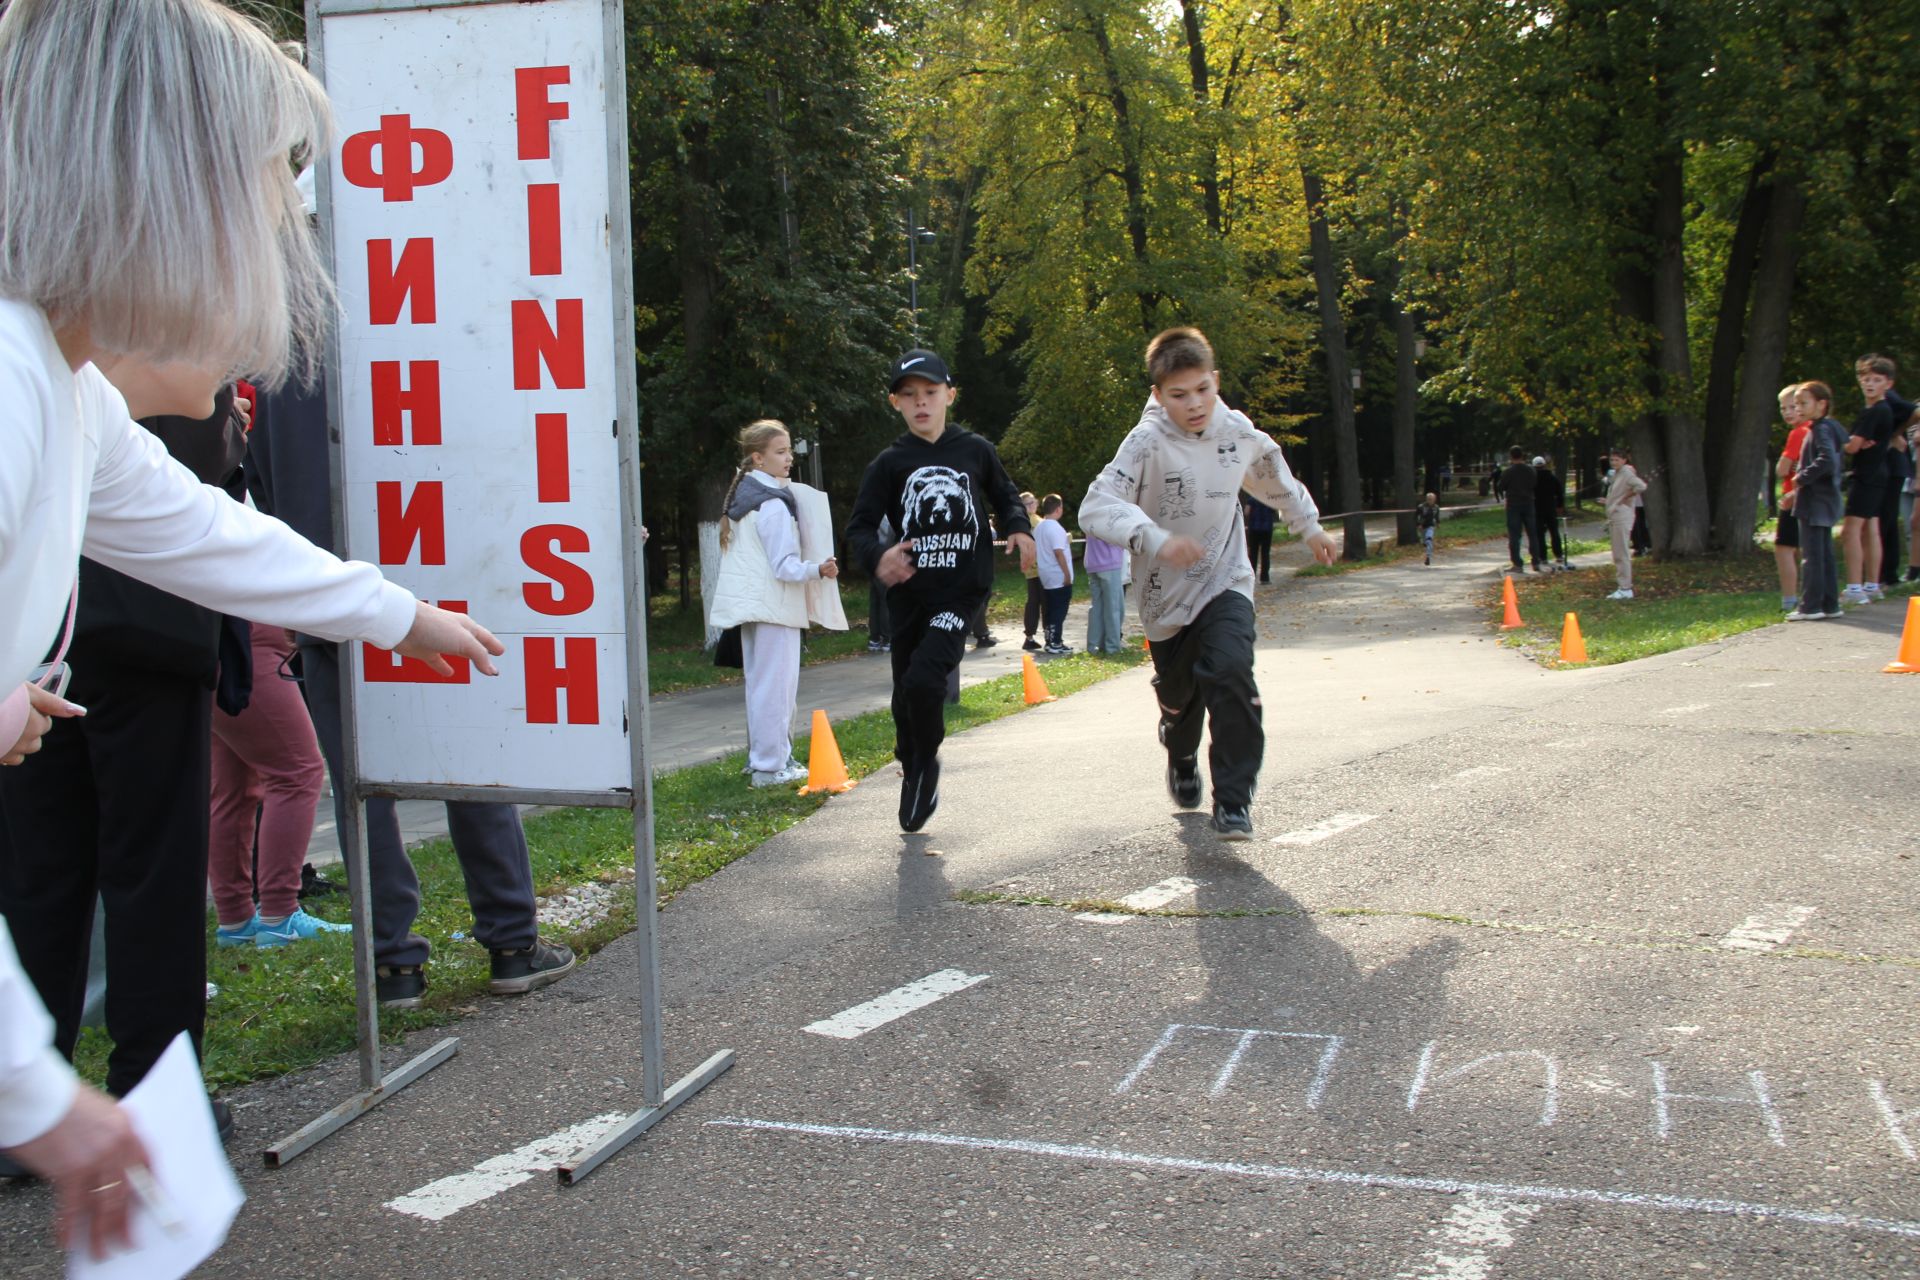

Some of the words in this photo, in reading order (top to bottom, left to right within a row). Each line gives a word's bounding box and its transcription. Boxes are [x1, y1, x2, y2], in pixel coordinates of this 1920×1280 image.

[511, 65, 600, 725] FINISH
[910, 532, 972, 552] RUSSIAN
[917, 551, 957, 568] BEAR
